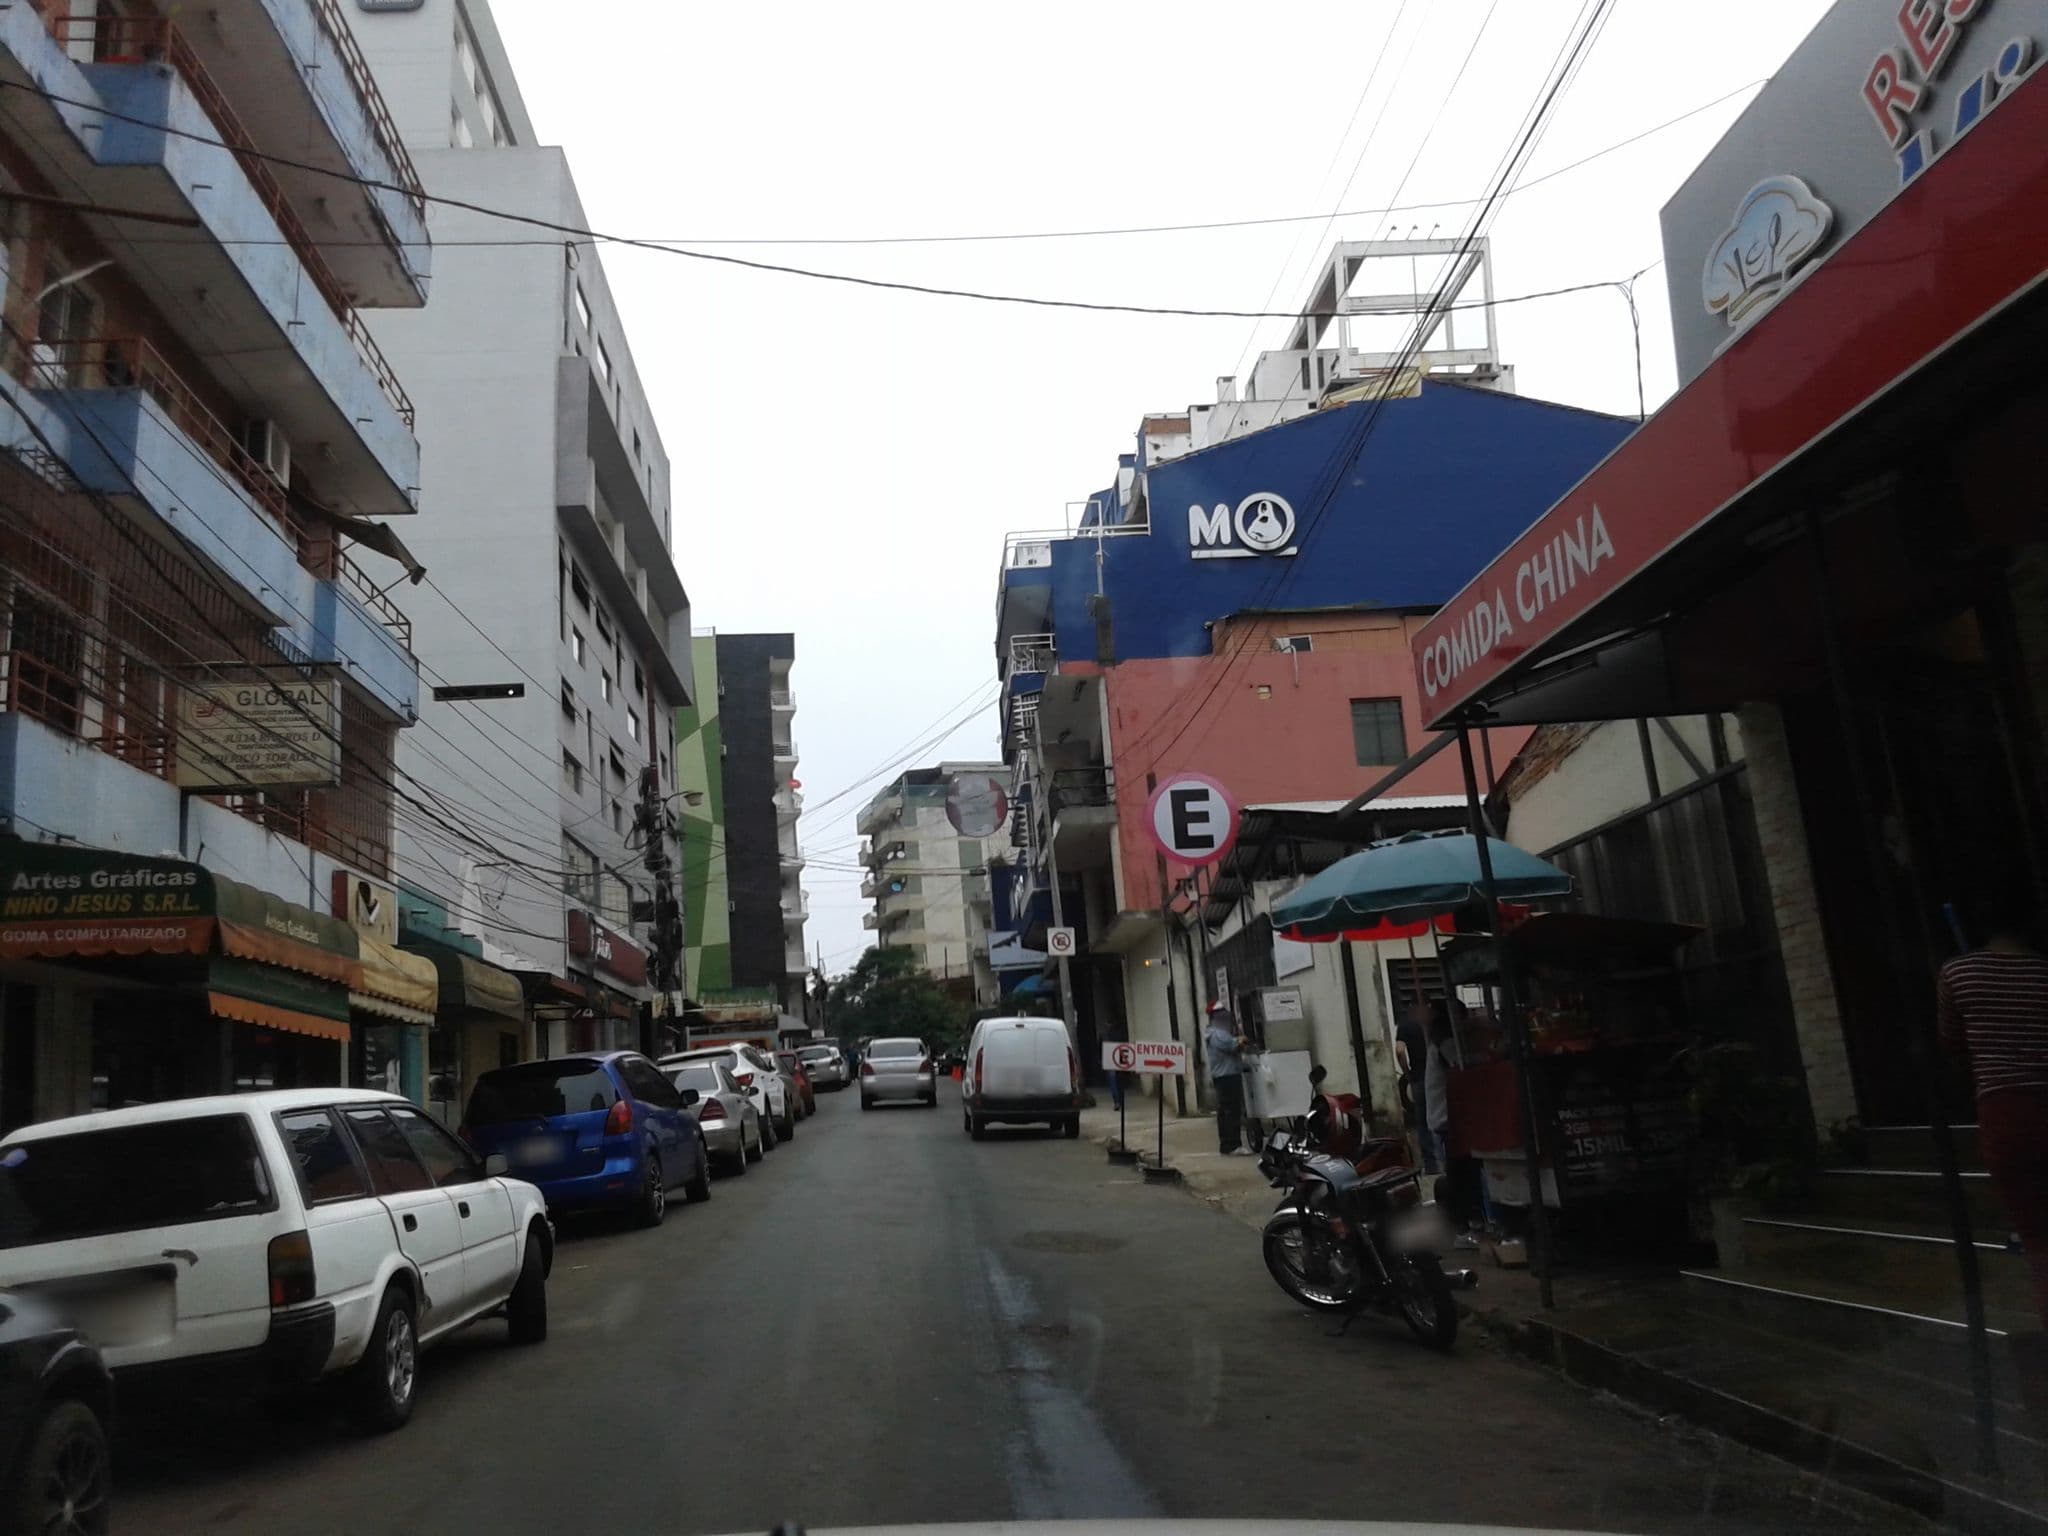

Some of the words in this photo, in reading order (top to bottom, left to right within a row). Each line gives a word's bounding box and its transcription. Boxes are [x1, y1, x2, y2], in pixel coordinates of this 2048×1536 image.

[1422, 586, 1513, 697] COMIDA
[1515, 503, 1615, 623] CHINA
[236, 689, 322, 706] GLOBAL
[311, 731, 322, 742] D
[1170, 788, 1215, 850] E
[12, 871, 82, 891] Artes
[90, 868, 197, 889] Gráficas
[4, 891, 59, 914] NIÑO
[142, 891, 201, 912] S.R.L.
[264, 912, 288, 934] Artes
[2, 928, 49, 944] GOMA
[54, 927, 187, 941] COMPUTARIZADO
[1136, 1043, 1185, 1057] ENTRADA
